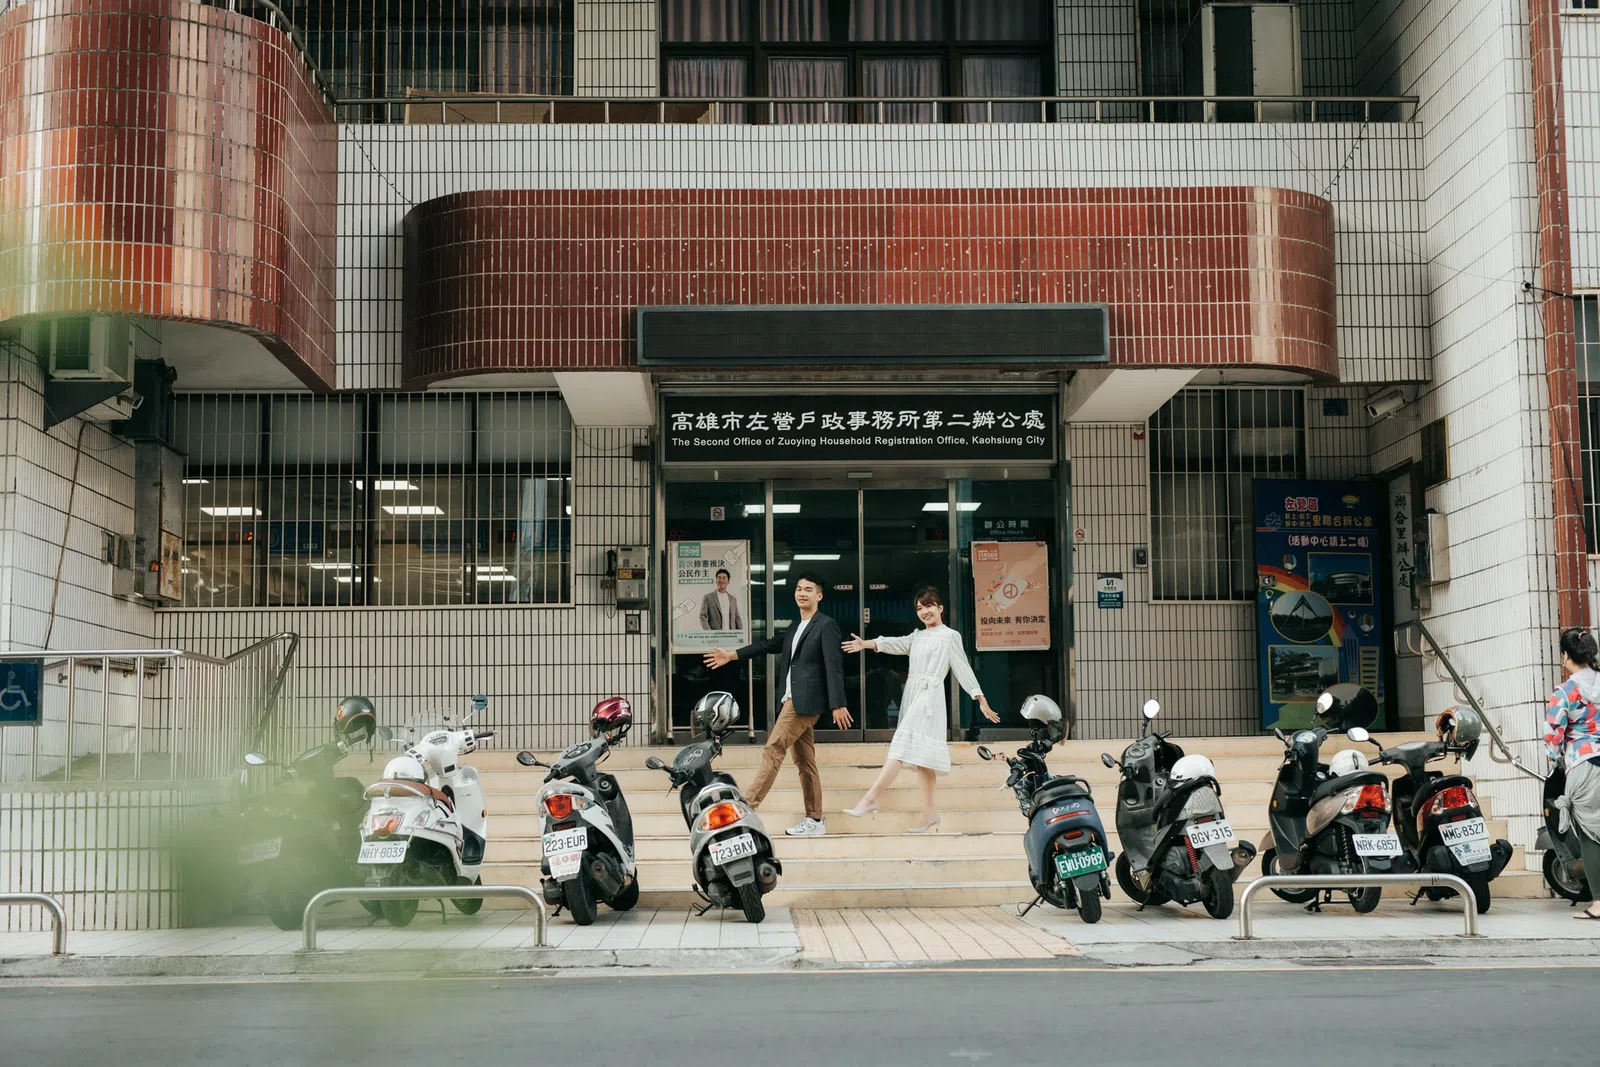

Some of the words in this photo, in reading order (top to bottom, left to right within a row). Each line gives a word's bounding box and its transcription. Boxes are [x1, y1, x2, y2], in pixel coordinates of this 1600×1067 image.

[671, 410, 1046, 431] 高雄市左營戶政事務所第二辦公處
[672, 438, 690, 446] The
[694, 438, 730, 446] Second
[733, 437, 762, 446] Office
[765, 437, 774, 446] of
[778, 437, 816, 447] Zuoying
[820, 436, 871, 446] Household
[875, 436, 933, 446] Registration
[937, 436, 968, 446] Office,
[972, 436, 1022, 446] Kaohsiung
[1026, 436, 1045, 446] City
[1285, 497, 1319, 511] 左營區
[984, 520, 1029, 529] 辦公時間
[679, 569, 709, 577] 公民作主
[980, 616, 1011, 625] 投向未來
[1015, 615, 1046, 624] 有你決定
[545, 835, 586, 852] 223-EUR
[712, 840, 754, 861] 723-BAV
[1059, 853, 1102, 874] EWU-0989
